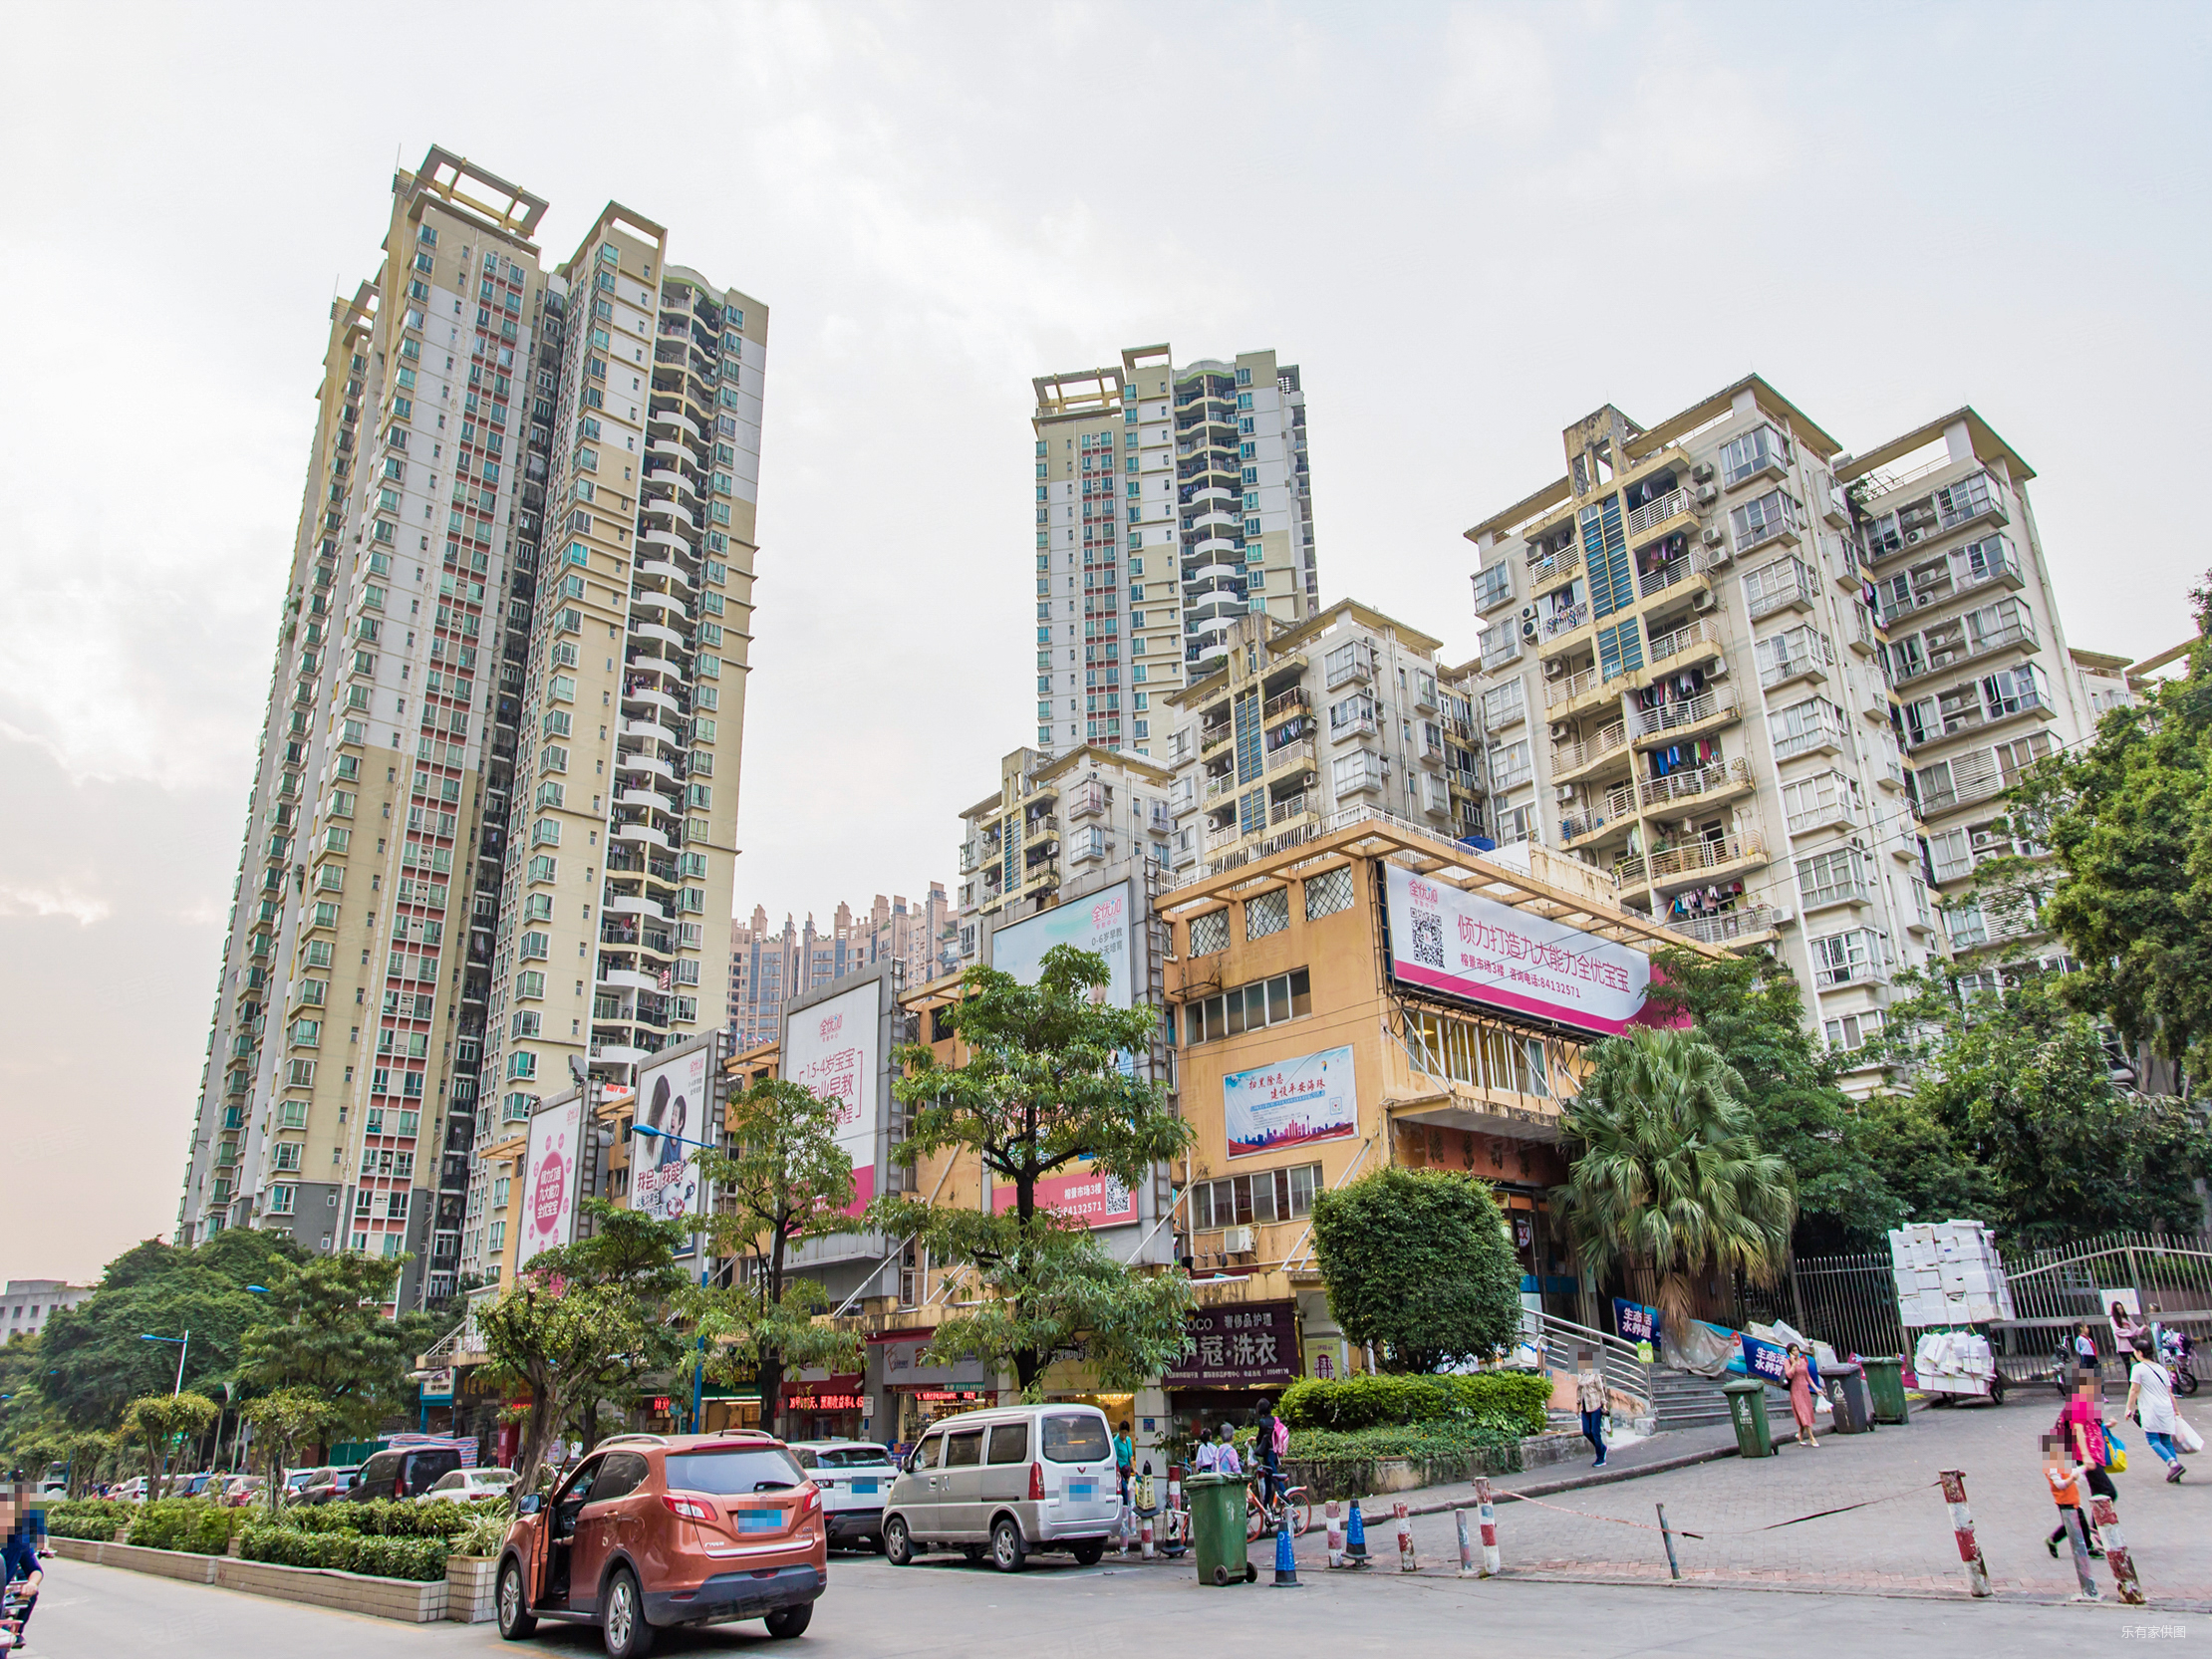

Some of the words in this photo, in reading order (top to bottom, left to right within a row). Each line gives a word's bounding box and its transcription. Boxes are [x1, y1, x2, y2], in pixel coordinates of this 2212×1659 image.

[1458, 914, 1631, 993] 倾力打造九大能力全优宝宝
[1510, 967, 1580, 997] 咨询电话:84132571
[806, 1047, 855, 1080] 1.5-4岁宝宝
[1248, 1072, 1283, 1090] 扫黑除恶
[1270, 1076, 1325, 1100] 建设平安海珠
[538, 1183, 560, 1202] 九大能力
[1224, 1312, 1273, 1329] 奢侈品护理
[1622, 1320, 1652, 1339] 水养殖
